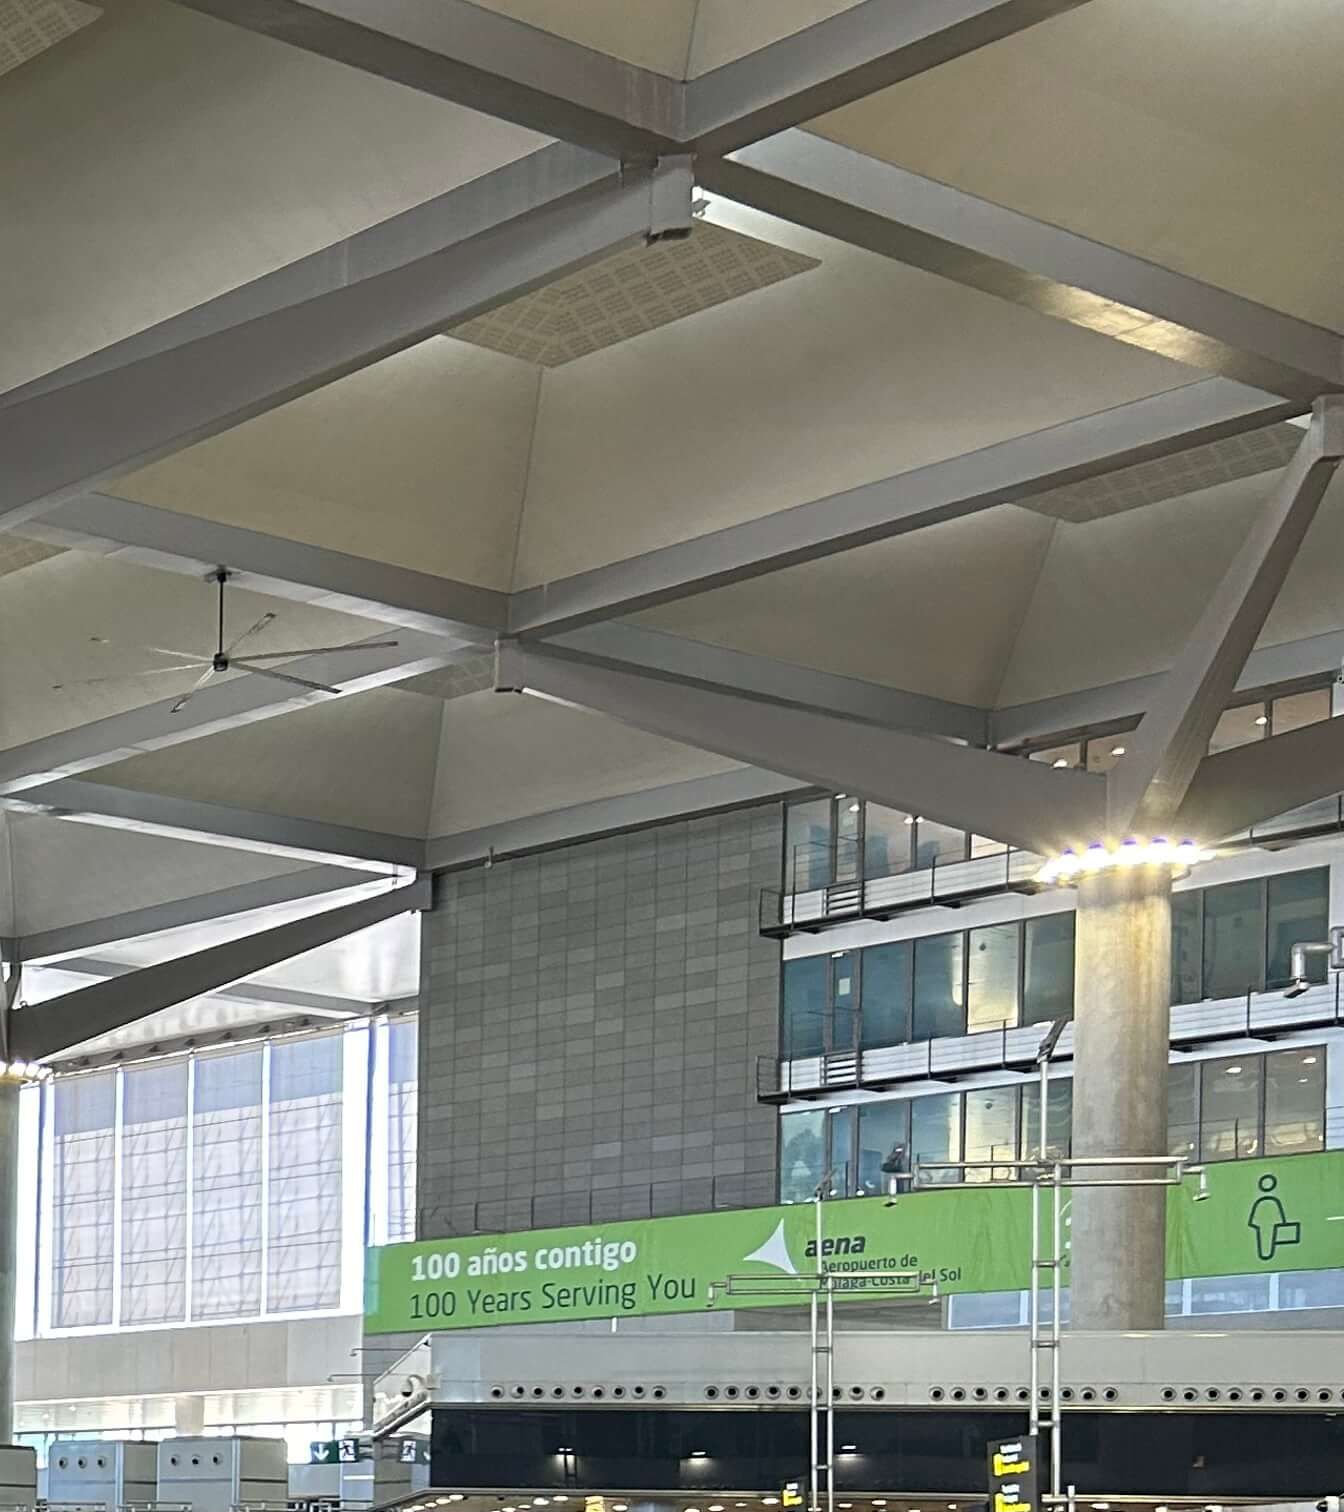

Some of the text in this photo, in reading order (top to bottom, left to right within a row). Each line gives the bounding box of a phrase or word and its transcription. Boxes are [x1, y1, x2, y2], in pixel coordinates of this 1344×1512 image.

[805, 1235, 866, 1258] aena
[411, 1237, 637, 1281] 100 años contigo
[900, 1254, 918, 1268] de
[939, 1267, 962, 1282] Sol
[409, 1273, 696, 1319] 100 Years Serving You
